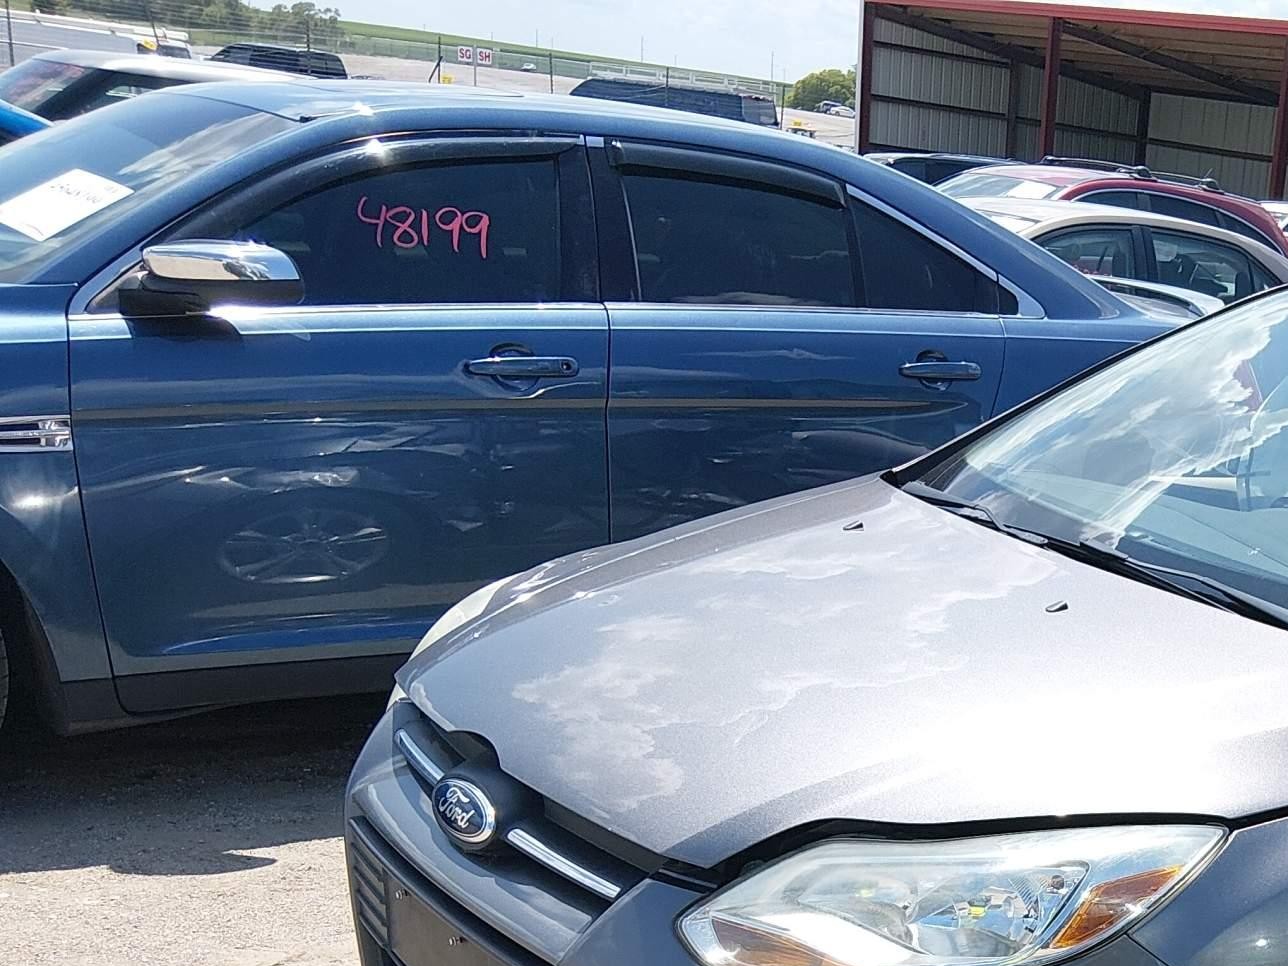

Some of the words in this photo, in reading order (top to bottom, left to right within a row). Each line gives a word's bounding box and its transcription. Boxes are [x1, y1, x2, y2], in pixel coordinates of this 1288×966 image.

[459, 48, 471, 59] SG
[479, 51, 491, 62] SH
[357, 196, 489, 259] 48199
[439, 786, 475, 829] Ford
